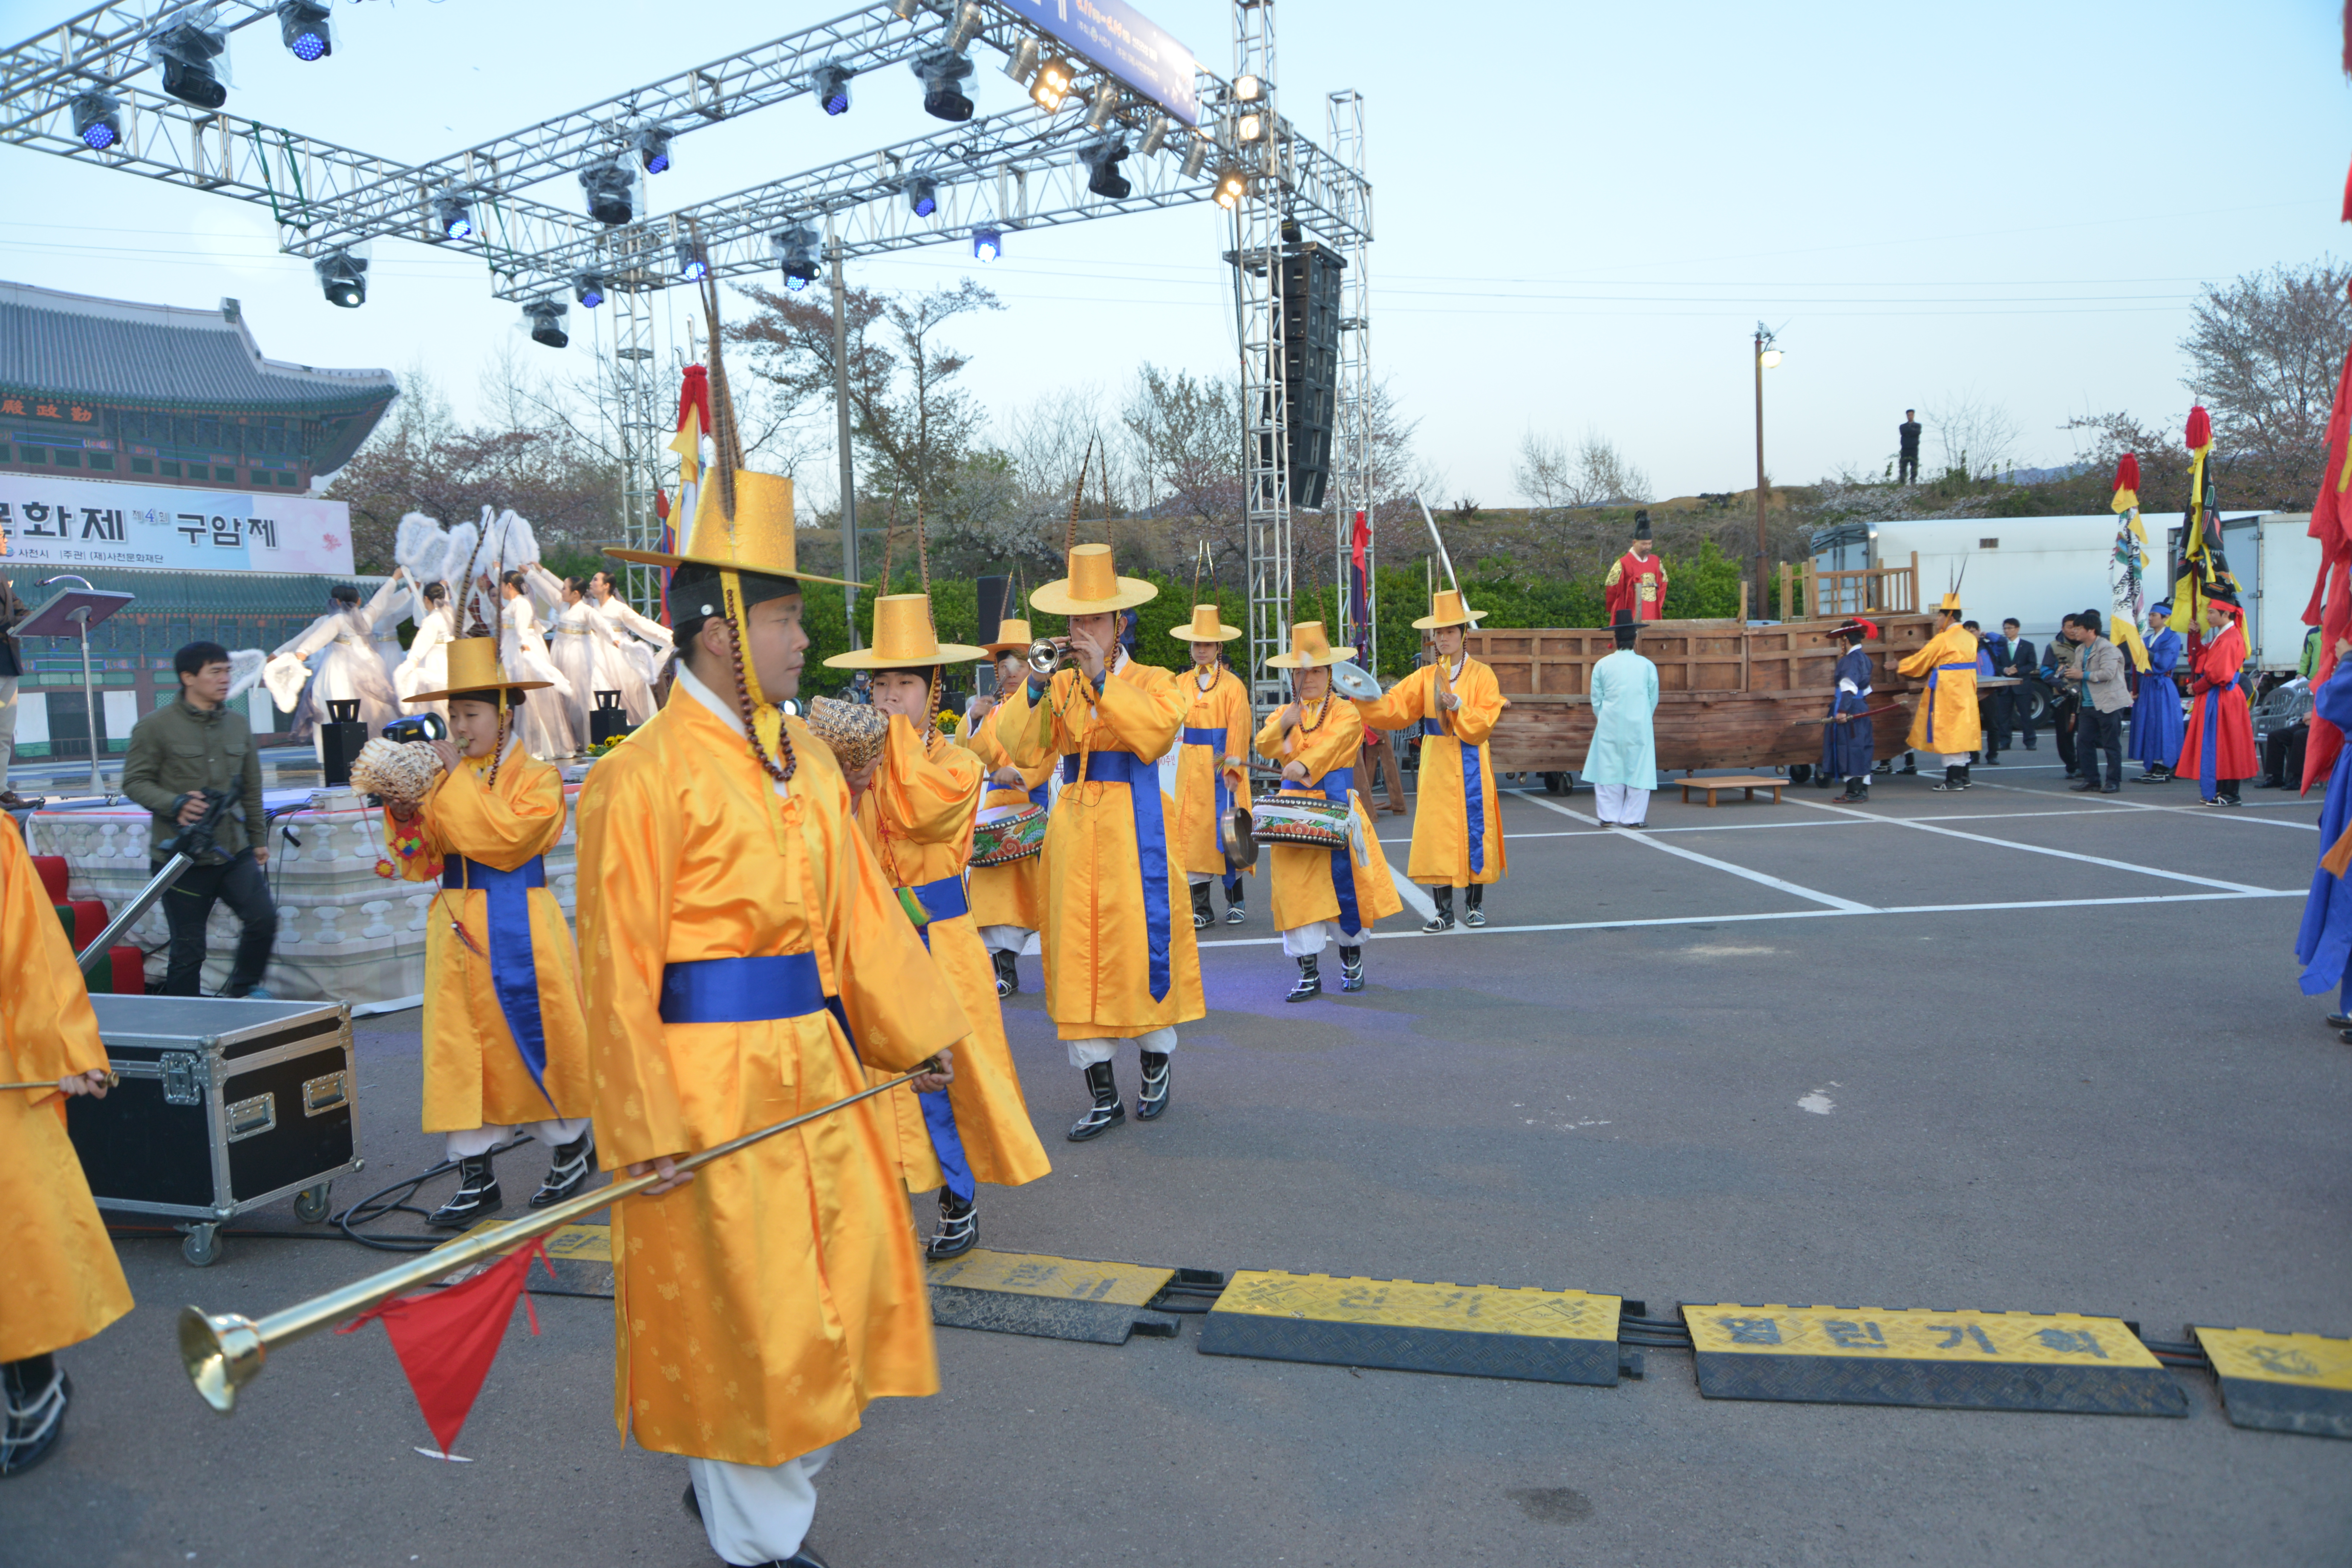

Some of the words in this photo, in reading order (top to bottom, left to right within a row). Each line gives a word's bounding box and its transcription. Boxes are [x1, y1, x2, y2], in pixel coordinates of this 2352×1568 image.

[133, 508, 167, 523] 제4회
[177, 513, 276, 548] 구암제
[19, 549, 49, 558] 사천시
[90, 551, 164, 563] (재)사천문화재단
